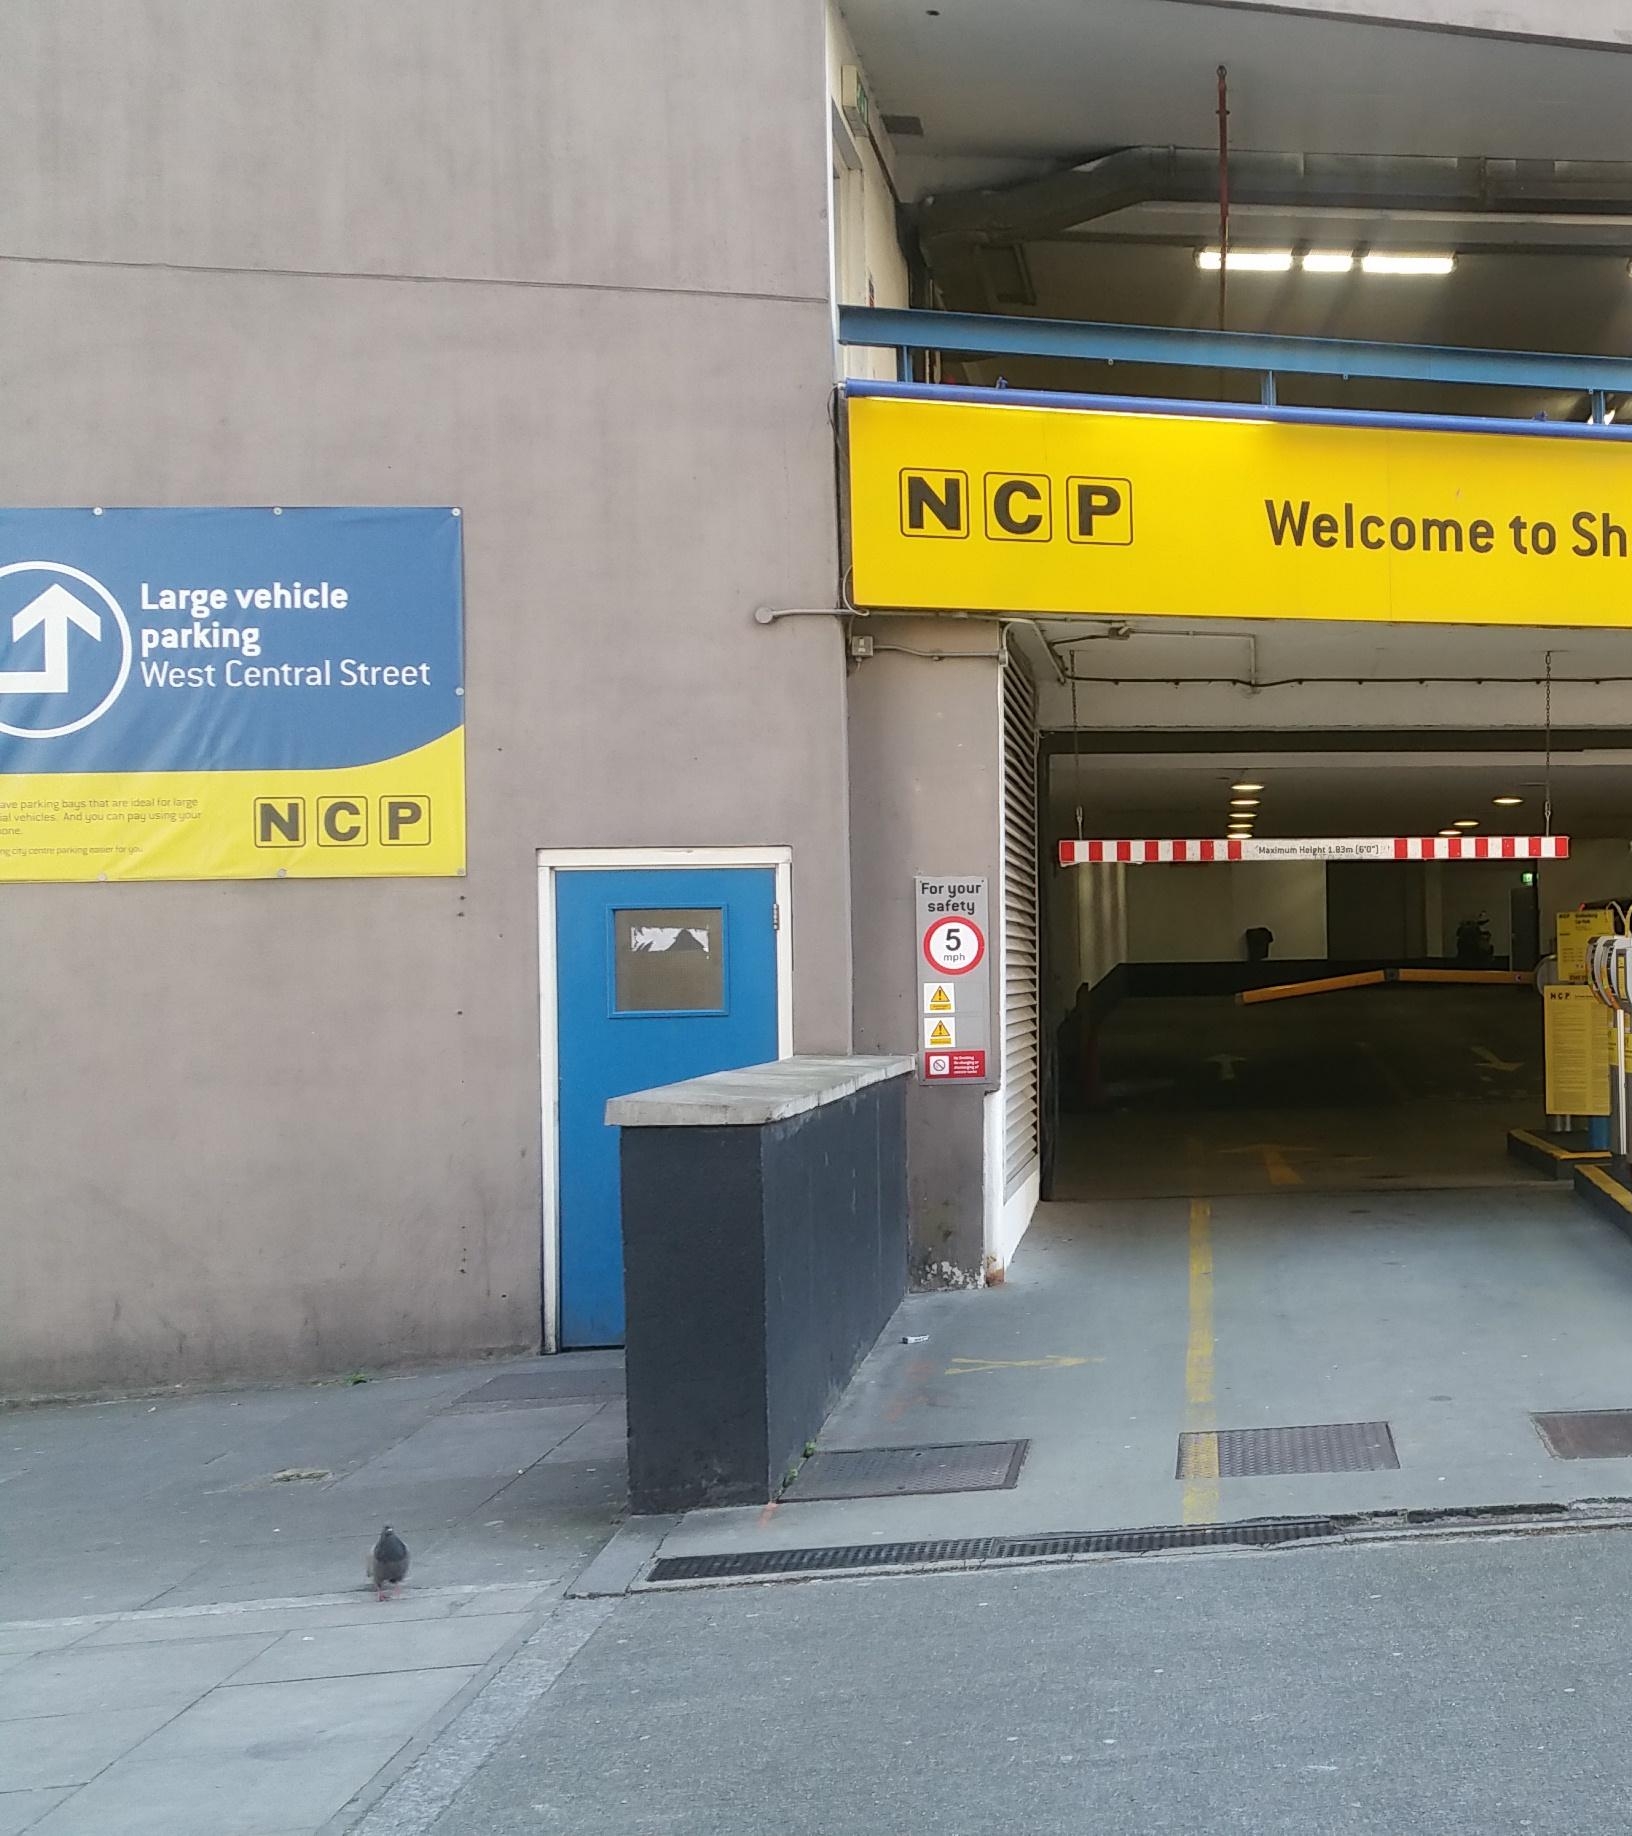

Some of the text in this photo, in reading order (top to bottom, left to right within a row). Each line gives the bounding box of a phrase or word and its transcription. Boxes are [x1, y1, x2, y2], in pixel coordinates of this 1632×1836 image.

[1265, 498, 1495, 553] Welcome
[1509, 516, 1557, 556] to
[140, 582, 349, 618] Large vehicle
[140, 621, 261, 657] parking
[140, 658, 431, 688] West Central Street
[0, 801, 18, 809] ave
[21, 800, 60, 811] parking
[62, 800, 86, 811] bays
[90, 799, 109, 808] that
[131, 798, 155, 807] ideal
[157, 797, 171, 807] for
[173, 797, 199, 809] large
[0, 812, 12, 822] al
[64, 812, 82, 821] And
[85, 814, 104, 823] you
[107, 813, 125, 821] can
[127, 813, 146, 823] pay
[149, 812, 177, 822] using
[178, 812, 202, 821] your
[0, 827, 24, 835] one.
[1258, 845, 1297, 854] Maximum
[1300, 845, 1326, 856] Height
[1328, 845, 1354, 854] 1.83m
[921, 882, 982, 899] For your
[927, 900, 975, 915] safety
[945, 928, 962, 951] 5
[943, 953, 966, 963] mph
